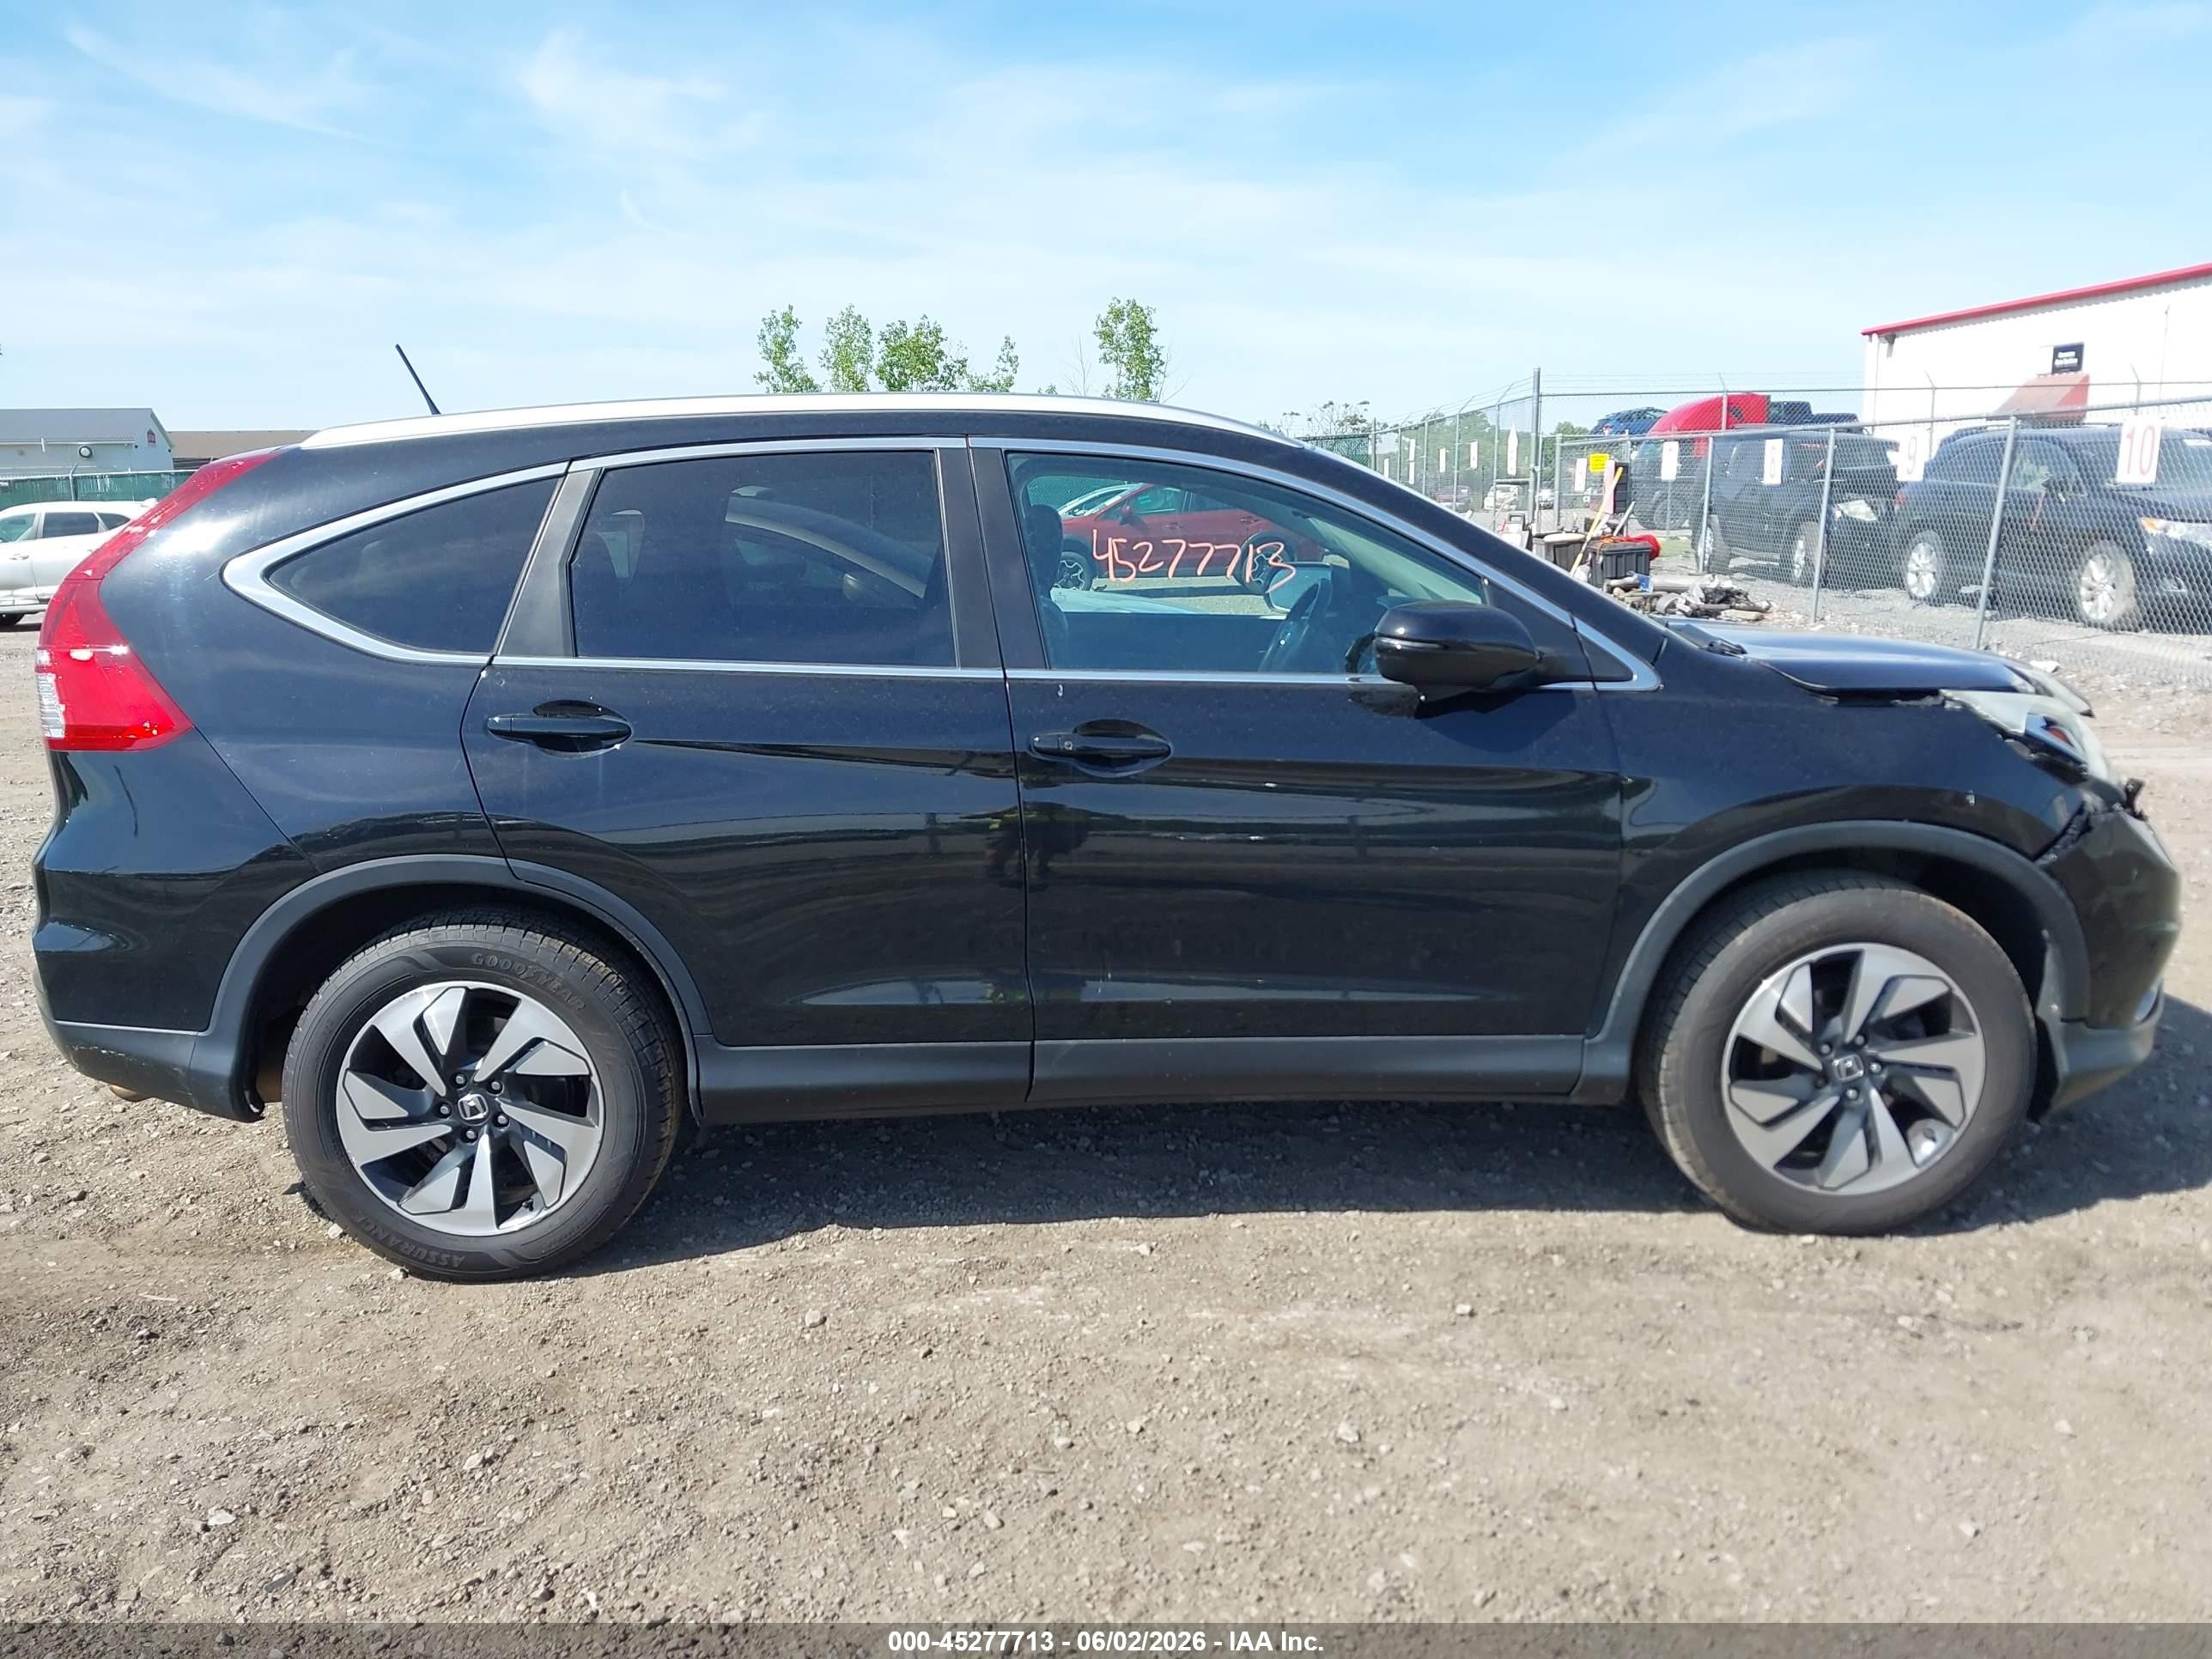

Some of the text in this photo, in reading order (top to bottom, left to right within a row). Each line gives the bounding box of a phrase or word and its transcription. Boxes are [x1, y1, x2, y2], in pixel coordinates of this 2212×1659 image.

[1906, 435, 1917, 474] 9
[2125, 424, 2155, 476] 10
[1091, 528, 1297, 593] 45277713
[473, 952, 586, 1011] GOODYEAR
